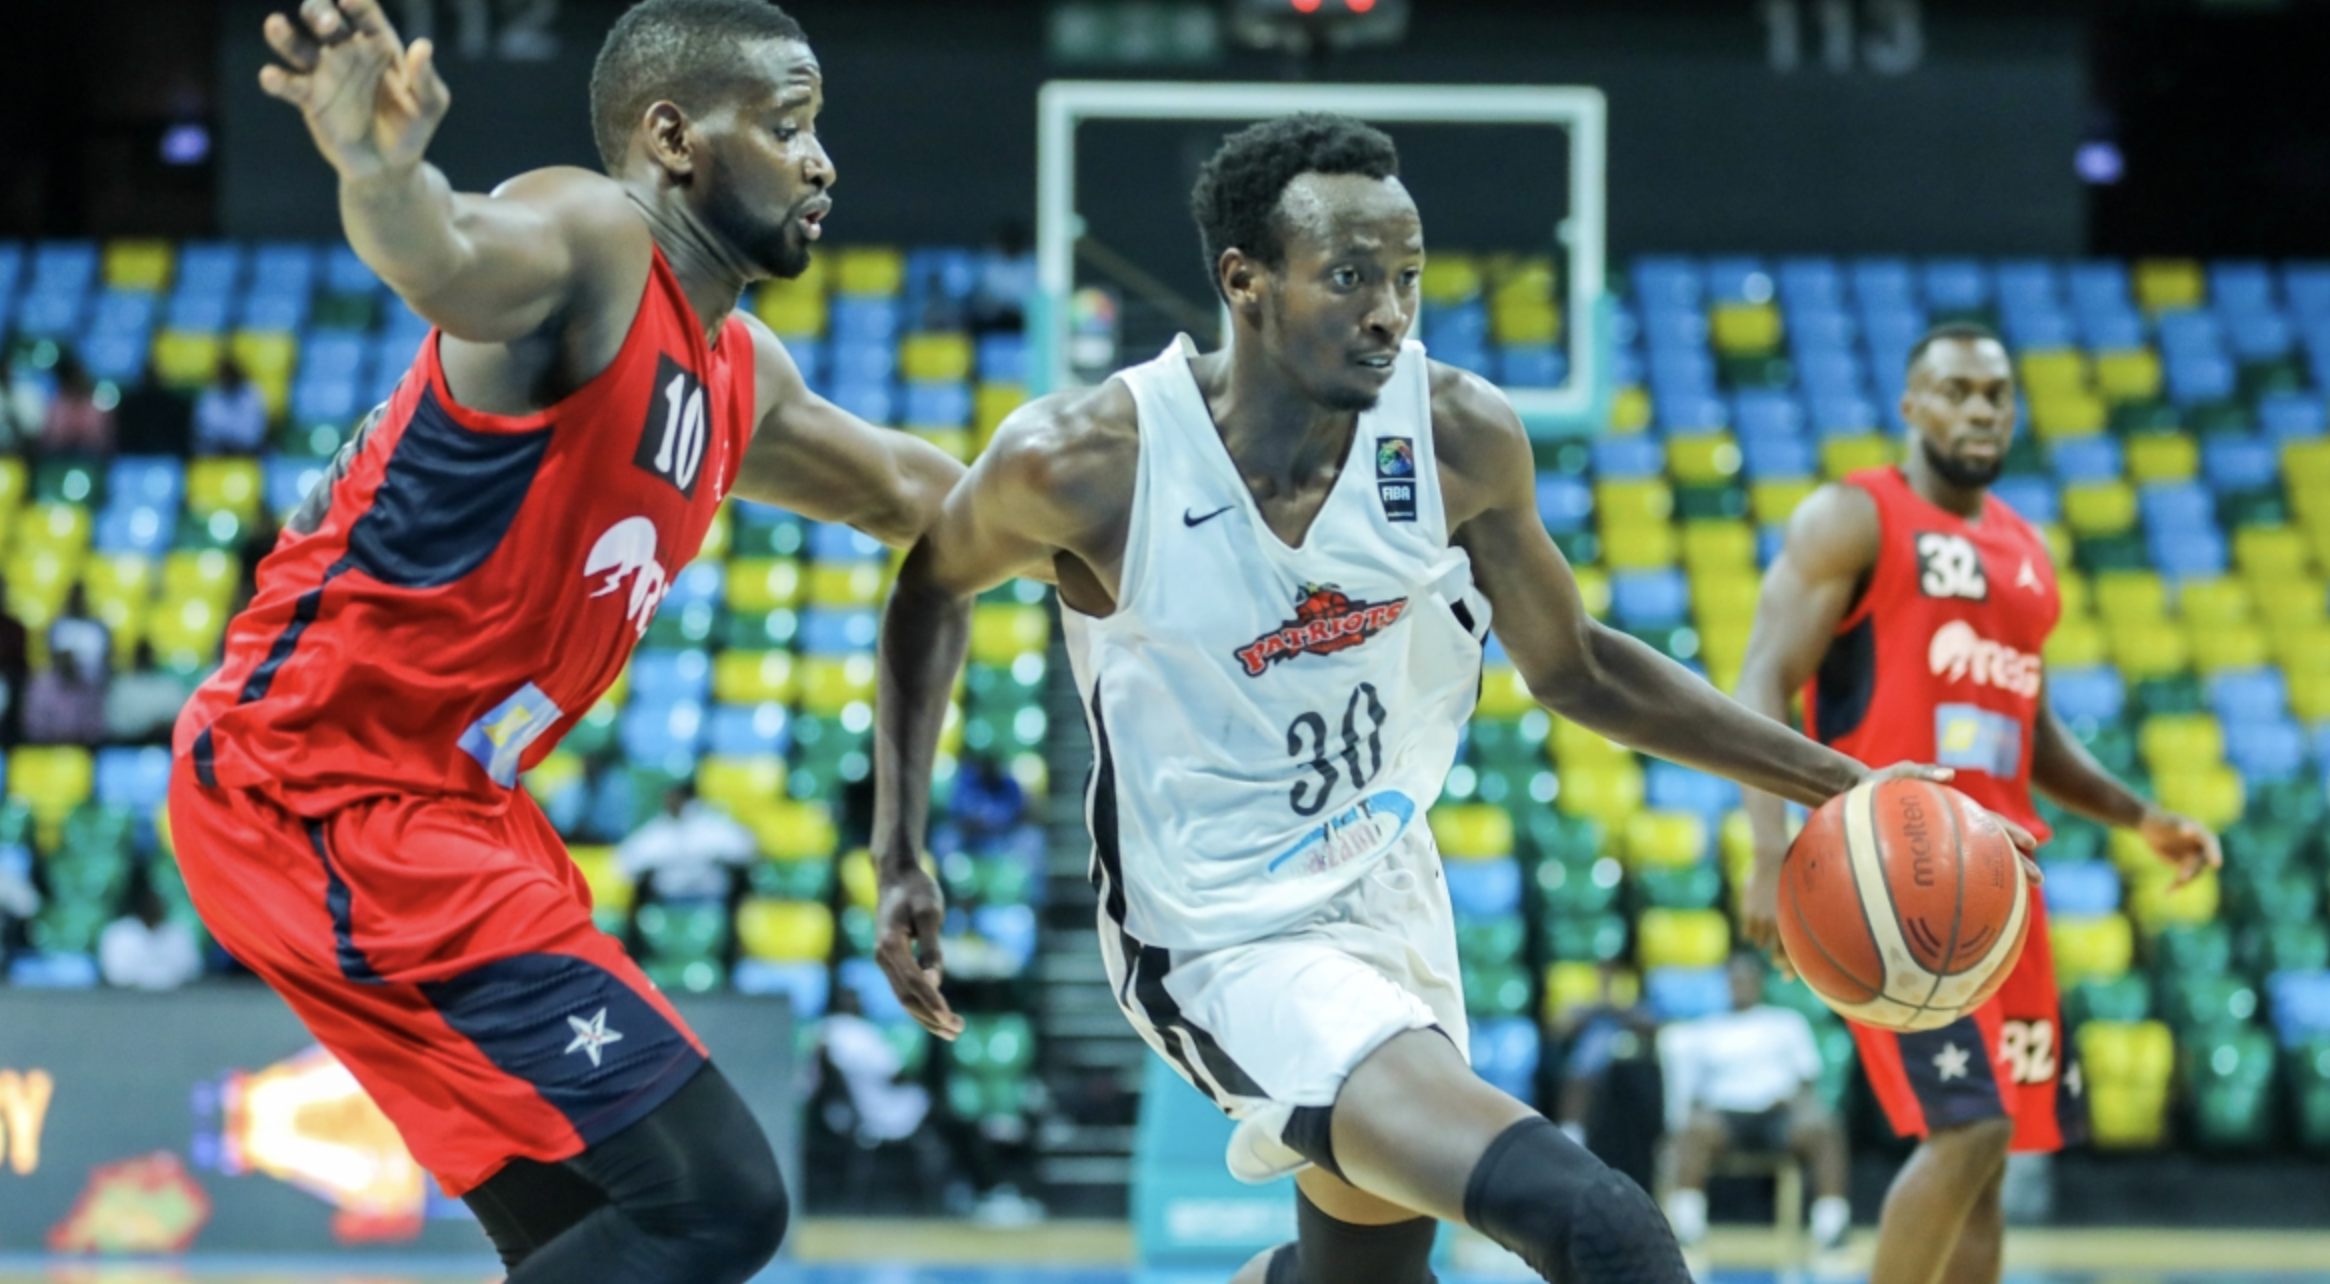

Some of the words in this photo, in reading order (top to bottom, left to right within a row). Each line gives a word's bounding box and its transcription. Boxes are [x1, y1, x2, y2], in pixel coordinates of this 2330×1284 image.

[655, 373, 705, 490] 10
[1382, 486, 1411, 501] FIBA
[1918, 534, 1988, 599] 32
[1239, 601, 1407, 674] PATRIOTS
[1288, 682, 1387, 816] 30
[1902, 796, 1935, 887] molten
[0, 1067, 54, 1177] Y
